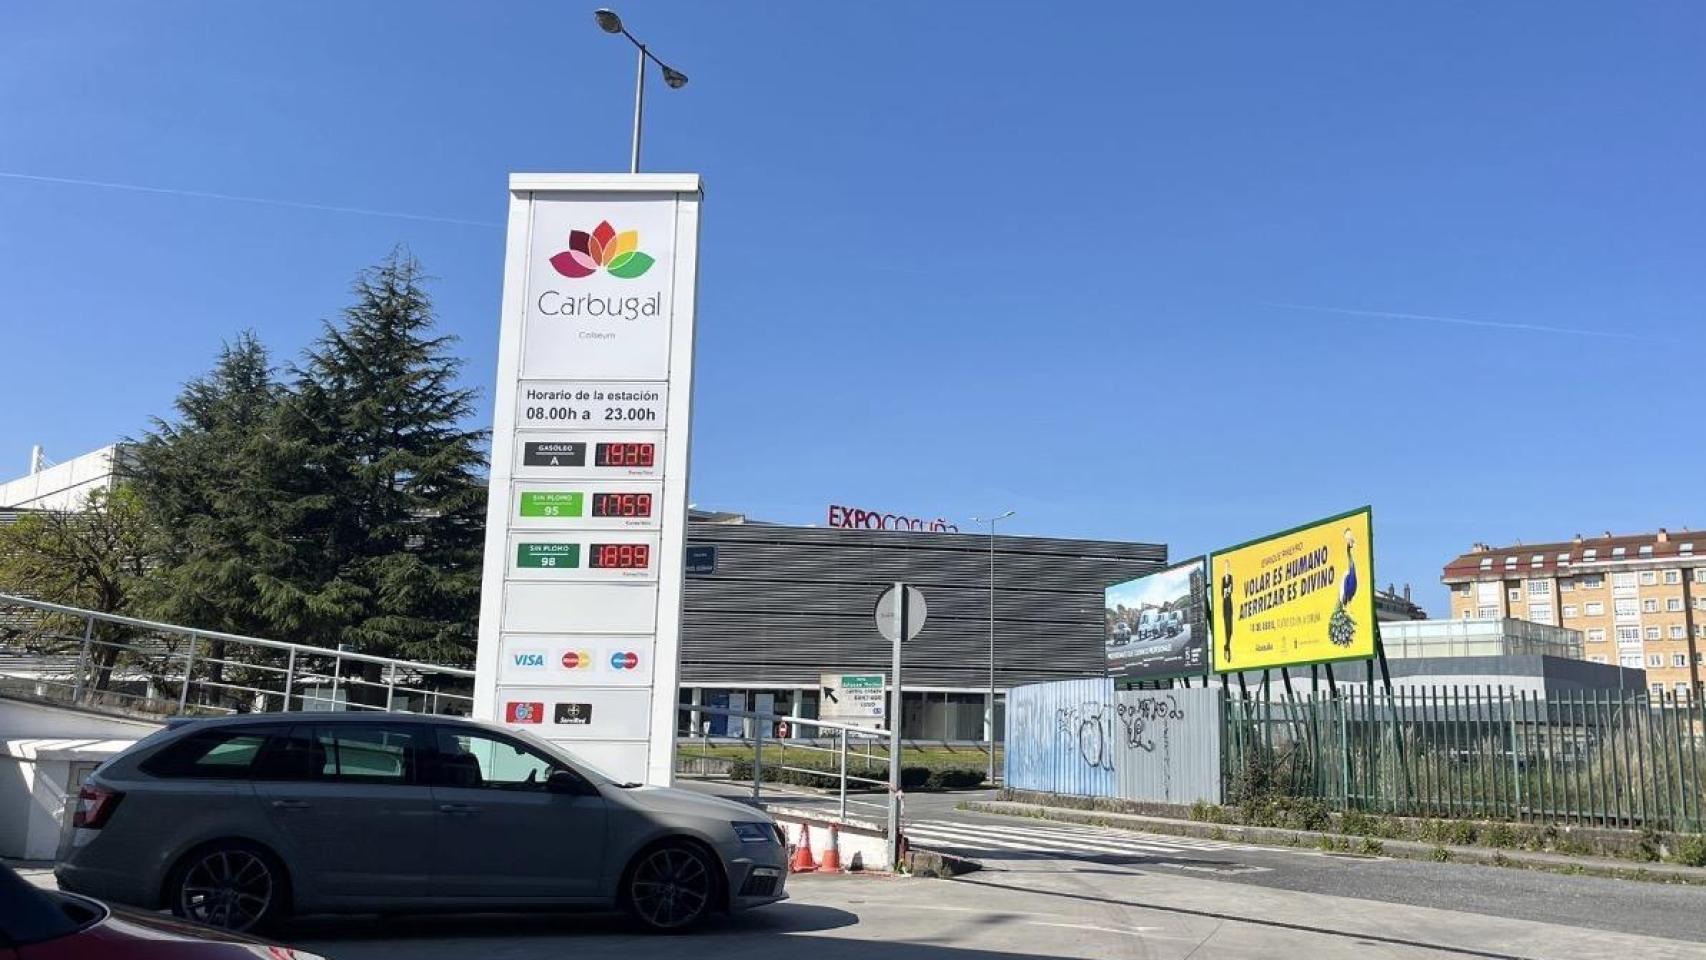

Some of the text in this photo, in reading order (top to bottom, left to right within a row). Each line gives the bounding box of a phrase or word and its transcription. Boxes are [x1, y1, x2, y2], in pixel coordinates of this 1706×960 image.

[538, 290, 661, 321] Carbugal
[527, 390, 659, 401] Horario de la estación
[526, 408, 656, 421] 08.00h a 23.00h
[550, 455, 559, 466] A
[544, 506, 559, 516] 95
[1243, 546, 1328, 598] VOLAR ES HUMANO
[1238, 588, 1285, 621] ATERRIZAR
[1286, 581, 1297, 602] ES
[1300, 565, 1335, 597] DIVINO
[514, 654, 544, 666] VISA
